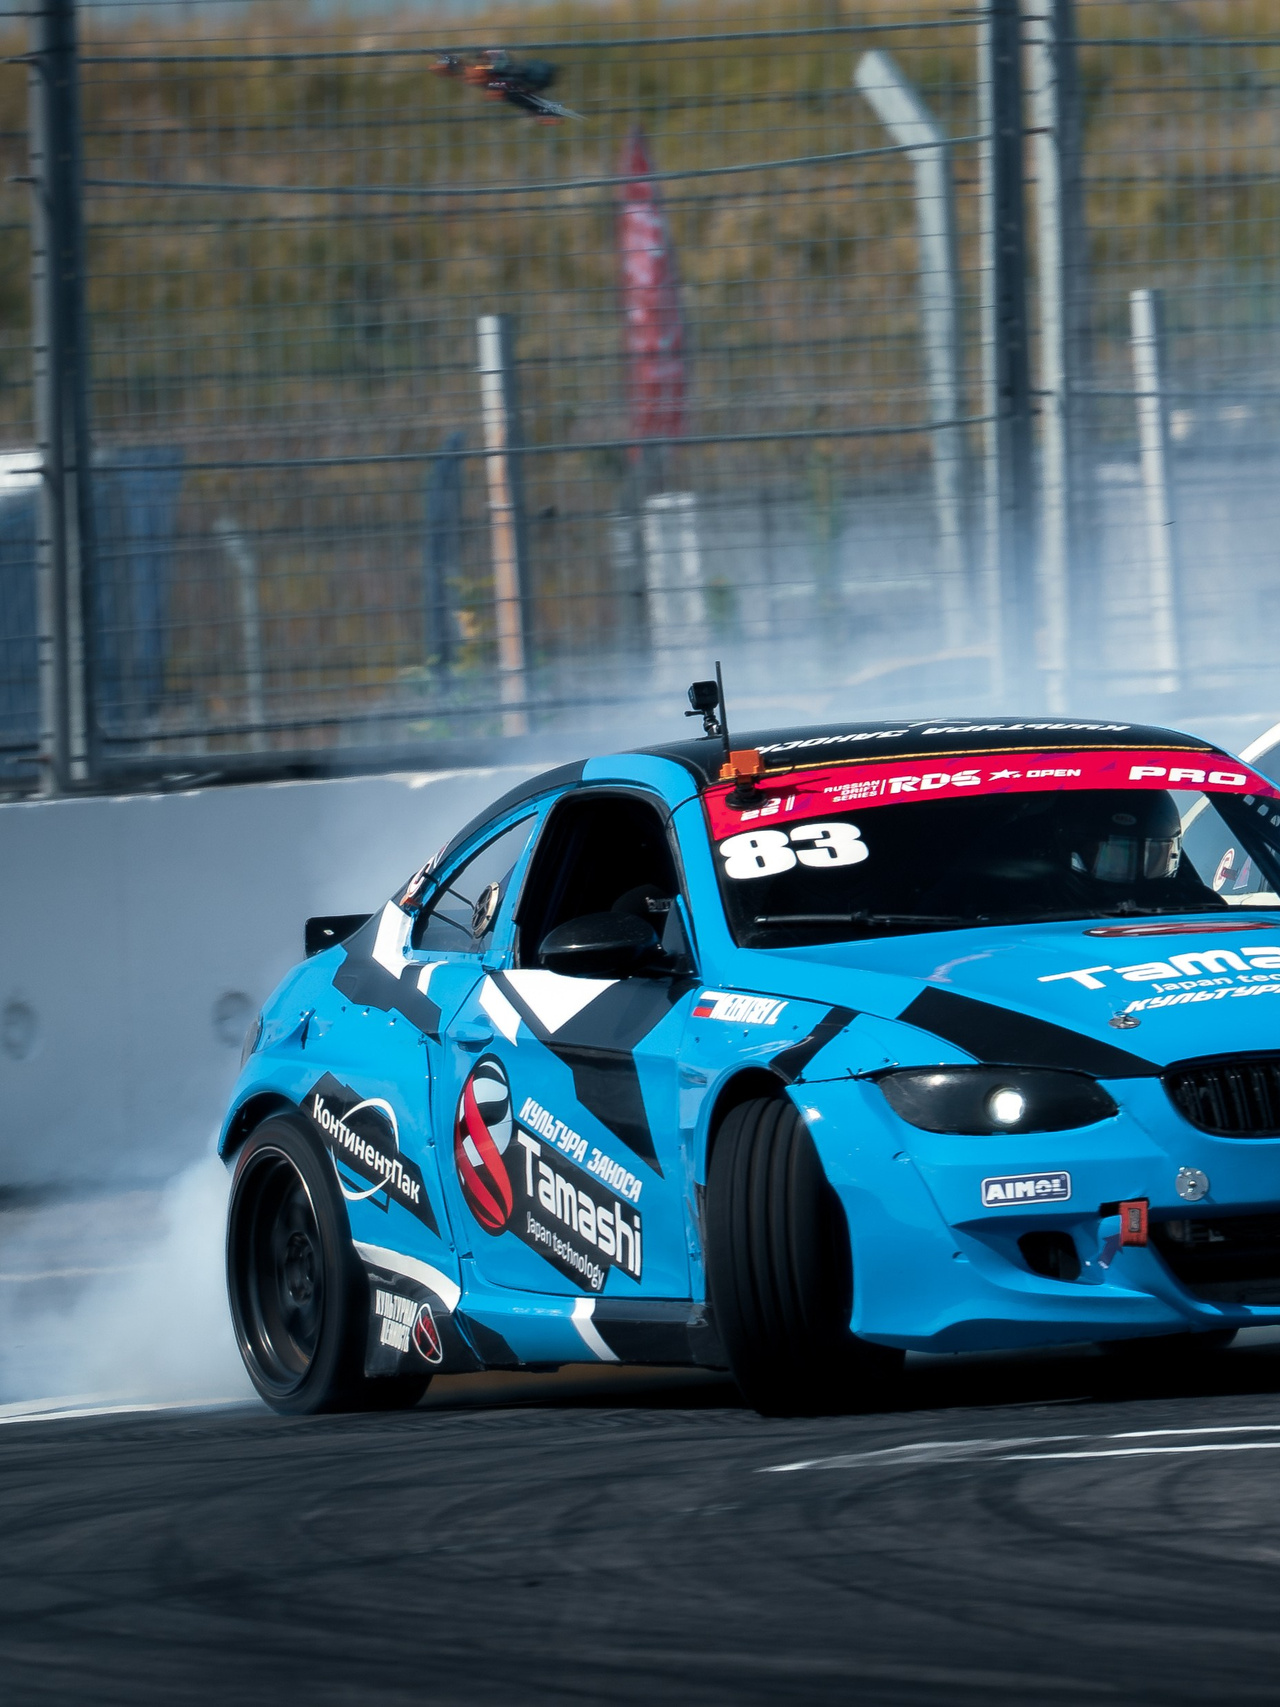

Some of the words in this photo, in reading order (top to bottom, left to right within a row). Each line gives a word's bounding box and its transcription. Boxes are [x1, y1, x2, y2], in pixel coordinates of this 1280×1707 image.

[824, 780, 880, 794] RUSSIAN
[889, 770, 981, 794] RDS
[1026, 769, 1081, 778] OPEN
[1129, 766, 1247, 786] PRO
[832, 792, 878, 803] SERIES
[841, 787, 880, 797] DRIFT
[718, 823, 869, 880] 83
[1151, 977, 1234, 994] Japan
[313, 1093, 421, 1203] КонтинентПак
[518, 1096, 588, 1160] КУЛЬТУРА
[587, 1148, 643, 1202] ЗАНОСА
[986, 1179, 1067, 1200] AIMOL
[517, 1130, 642, 1276] Tamashi
[526, 1211, 552, 1252] Japan
[552, 1232, 605, 1290] technology
